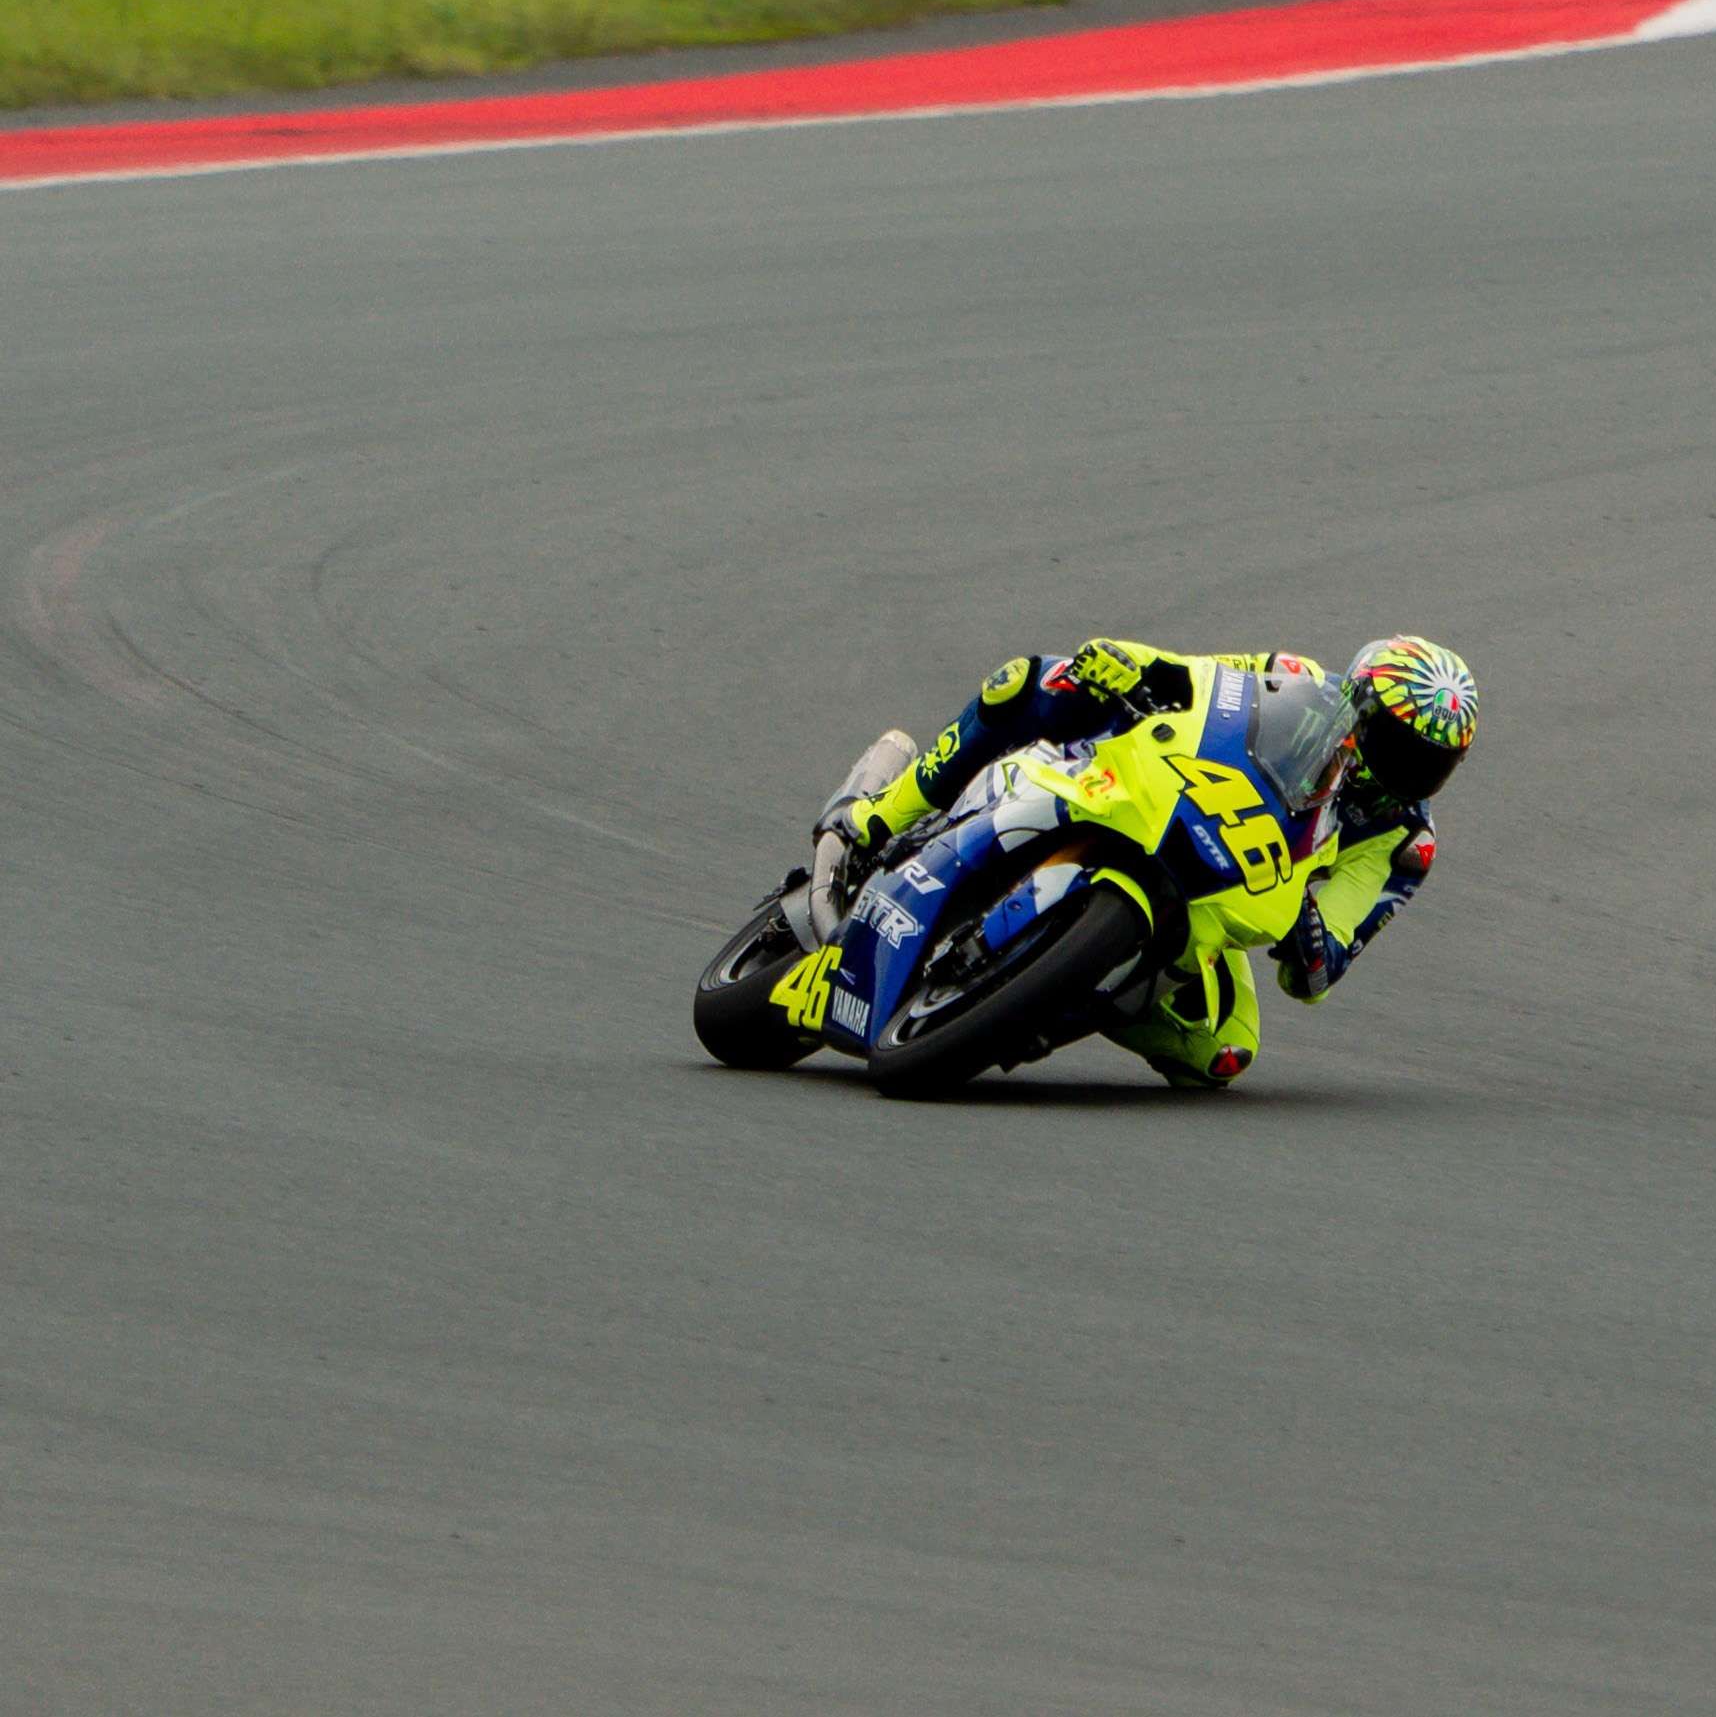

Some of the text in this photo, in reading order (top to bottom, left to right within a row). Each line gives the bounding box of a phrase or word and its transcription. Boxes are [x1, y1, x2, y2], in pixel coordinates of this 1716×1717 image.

[1161, 754, 1293, 895] 46
[1192, 824, 1230, 870] GYTR
[769, 945, 843, 1031] 46
[832, 986, 870, 1037] YAMAHA
